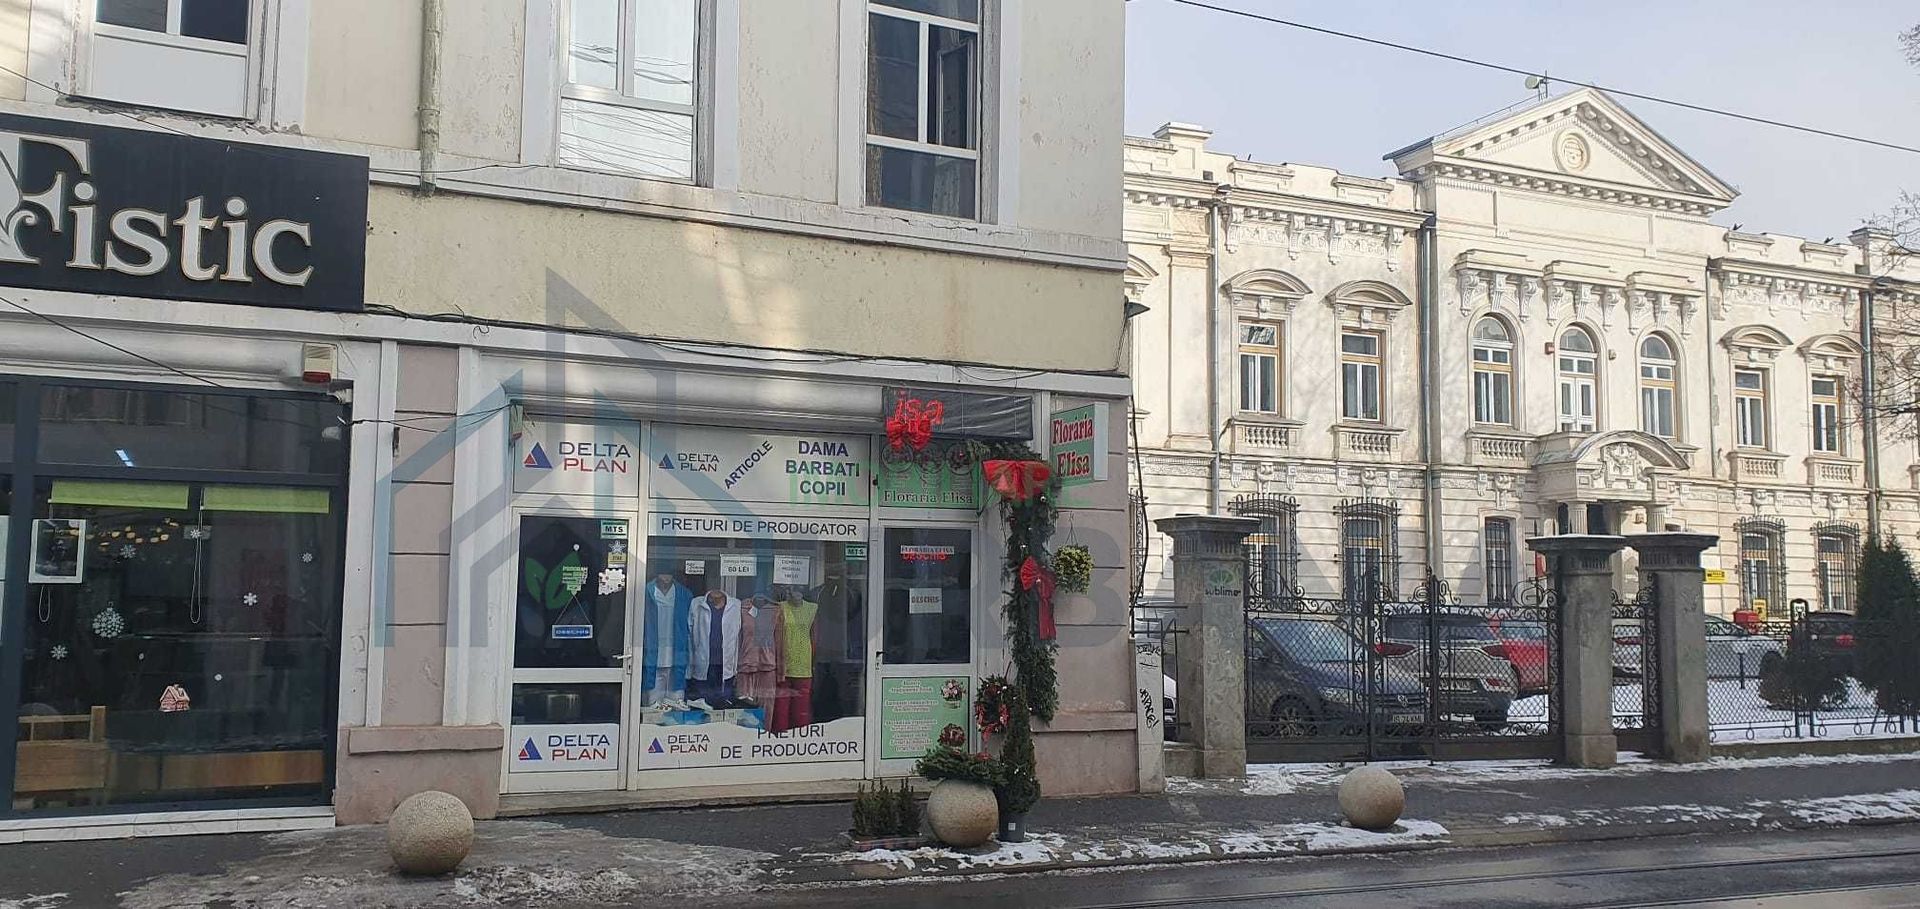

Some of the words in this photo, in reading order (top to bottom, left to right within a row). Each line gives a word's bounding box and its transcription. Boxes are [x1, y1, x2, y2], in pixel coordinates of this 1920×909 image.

[0, 130, 314, 287] Fistic
[559, 441, 631, 457] DELTA
[798, 441, 849, 457] DAMA
[563, 458, 627, 473] PLAN
[677, 452, 720, 463] DELTA
[725, 440, 773, 489] ARTICOLE
[1056, 451, 1090, 477] Elisa
[680, 462, 717, 472] PLAN
[785, 460, 860, 477] BARBATI
[799, 480, 846, 496] COPII
[661, 517, 728, 531] PRETURI
[733, 520, 754, 533] DE
[757, 521, 857, 536] PRODUCATOR
[548, 734, 610, 747] DELTA
[667, 734, 711, 744] DELTA
[551, 748, 607, 761] PLAN
[670, 744, 708, 754] PLAN
[720, 745, 743, 759] DE
[751, 741, 858, 758] PRODUCATOR
